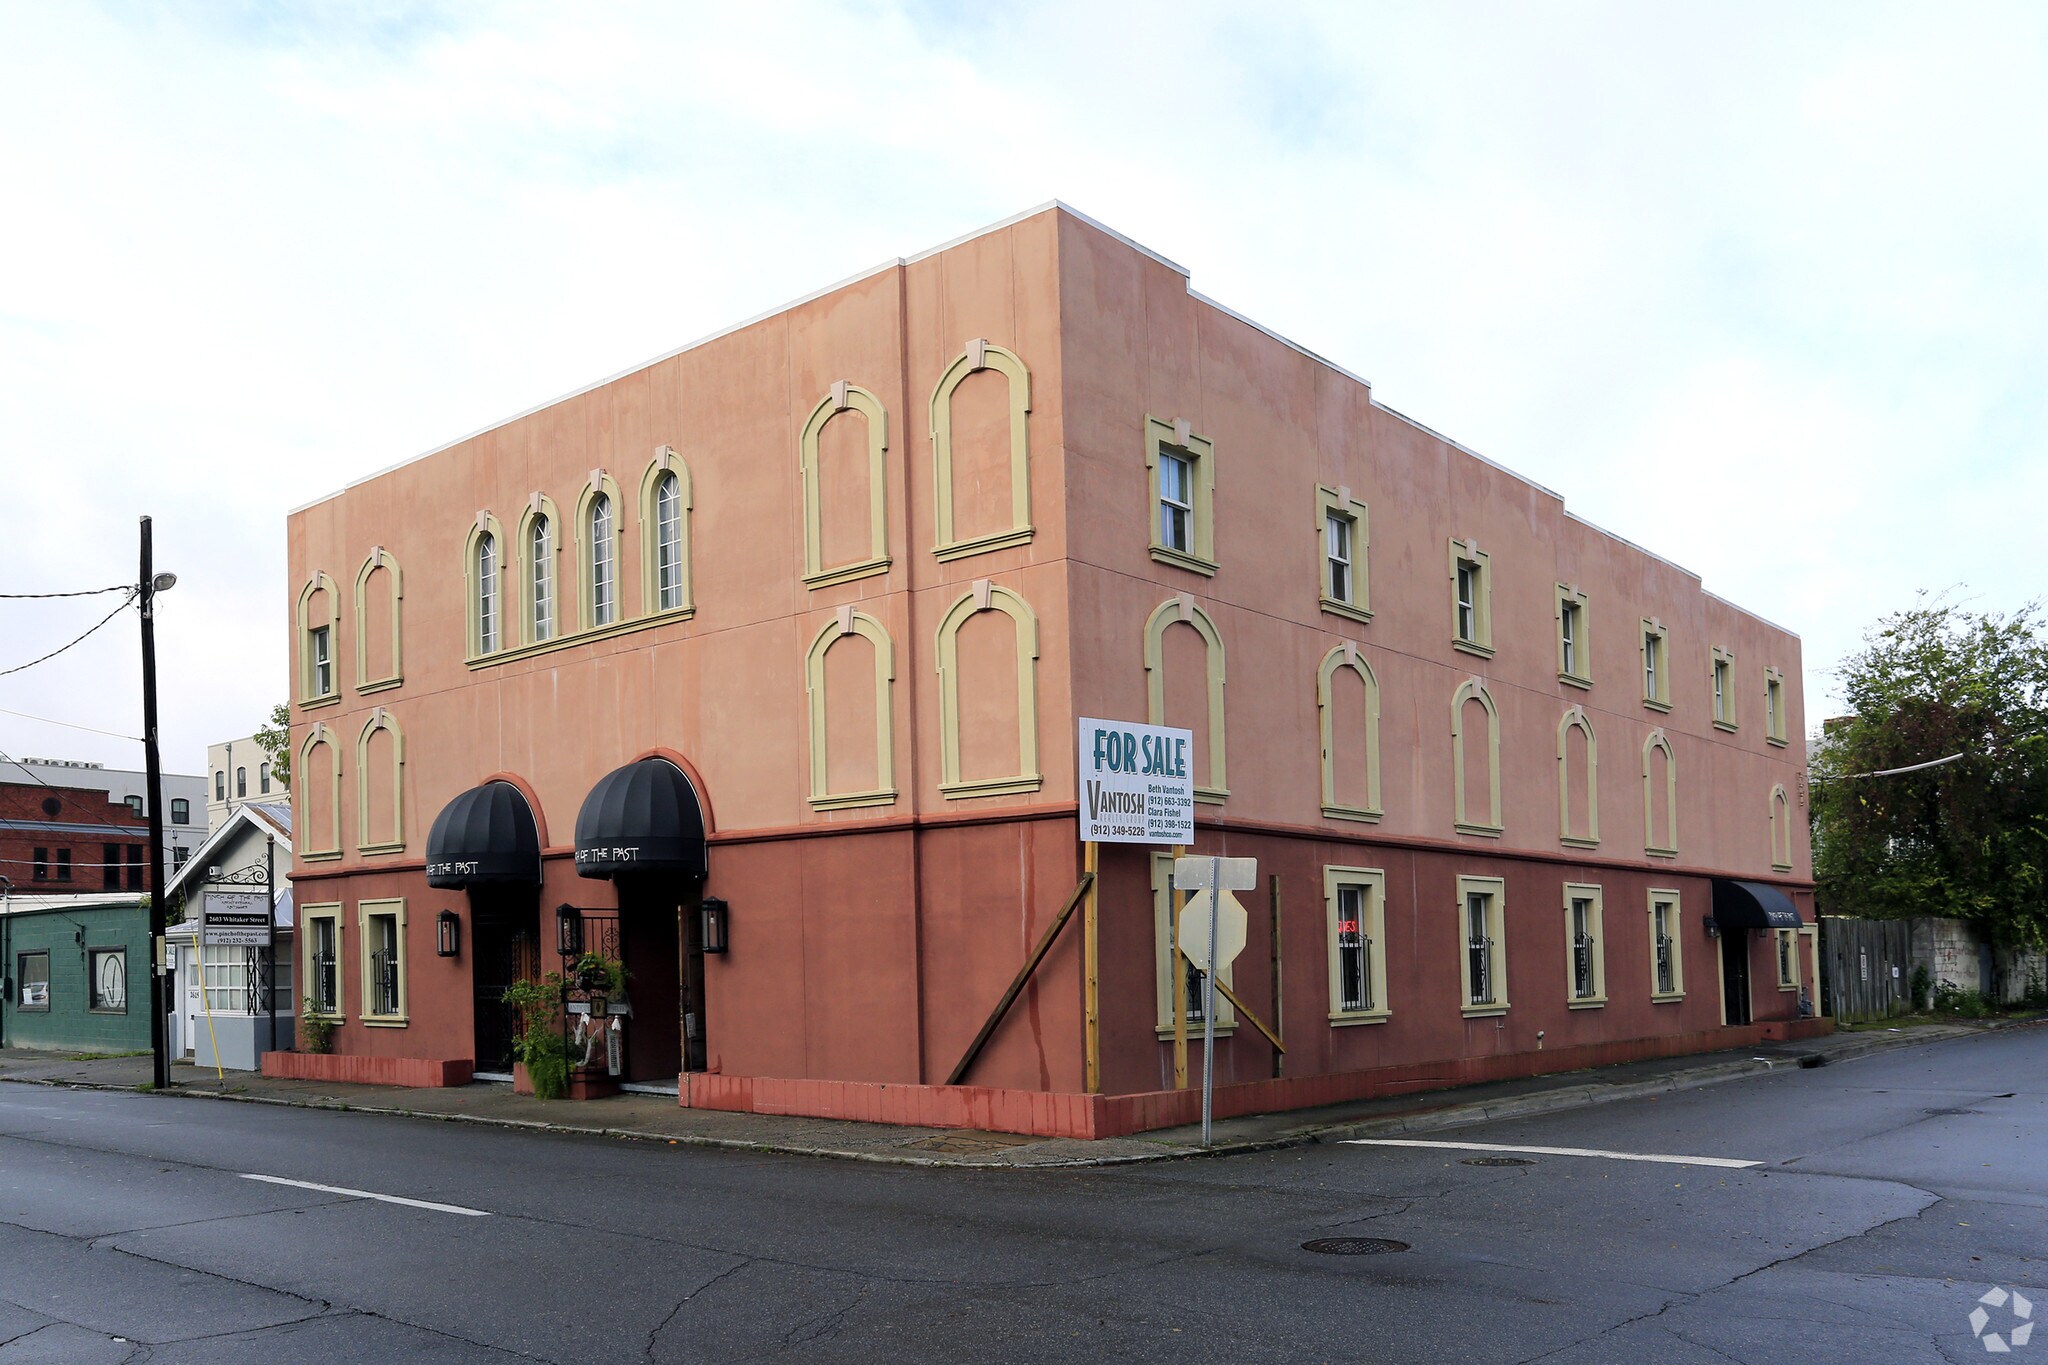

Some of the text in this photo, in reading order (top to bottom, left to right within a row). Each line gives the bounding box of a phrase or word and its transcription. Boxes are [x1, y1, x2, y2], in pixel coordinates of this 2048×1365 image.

[1093, 728, 1187, 779] FOR SALE
[1147, 783, 1185, 795] Beth Vantosh
[1086, 780, 1145, 820] VANTOSH
[1147, 795, 1191, 807] (912) 663-3392
[1147, 806, 1181, 817] Clara Fishel
[1147, 818, 1191, 830] (912) 398-1522
[1090, 824, 1145, 837] (912) 349-5226
[590, 847, 608, 863] THE
[612, 847, 640, 862] PAST
[437, 862, 452, 876] THE
[455, 861, 479, 875] PAST
[239, 894, 252, 902] THE
